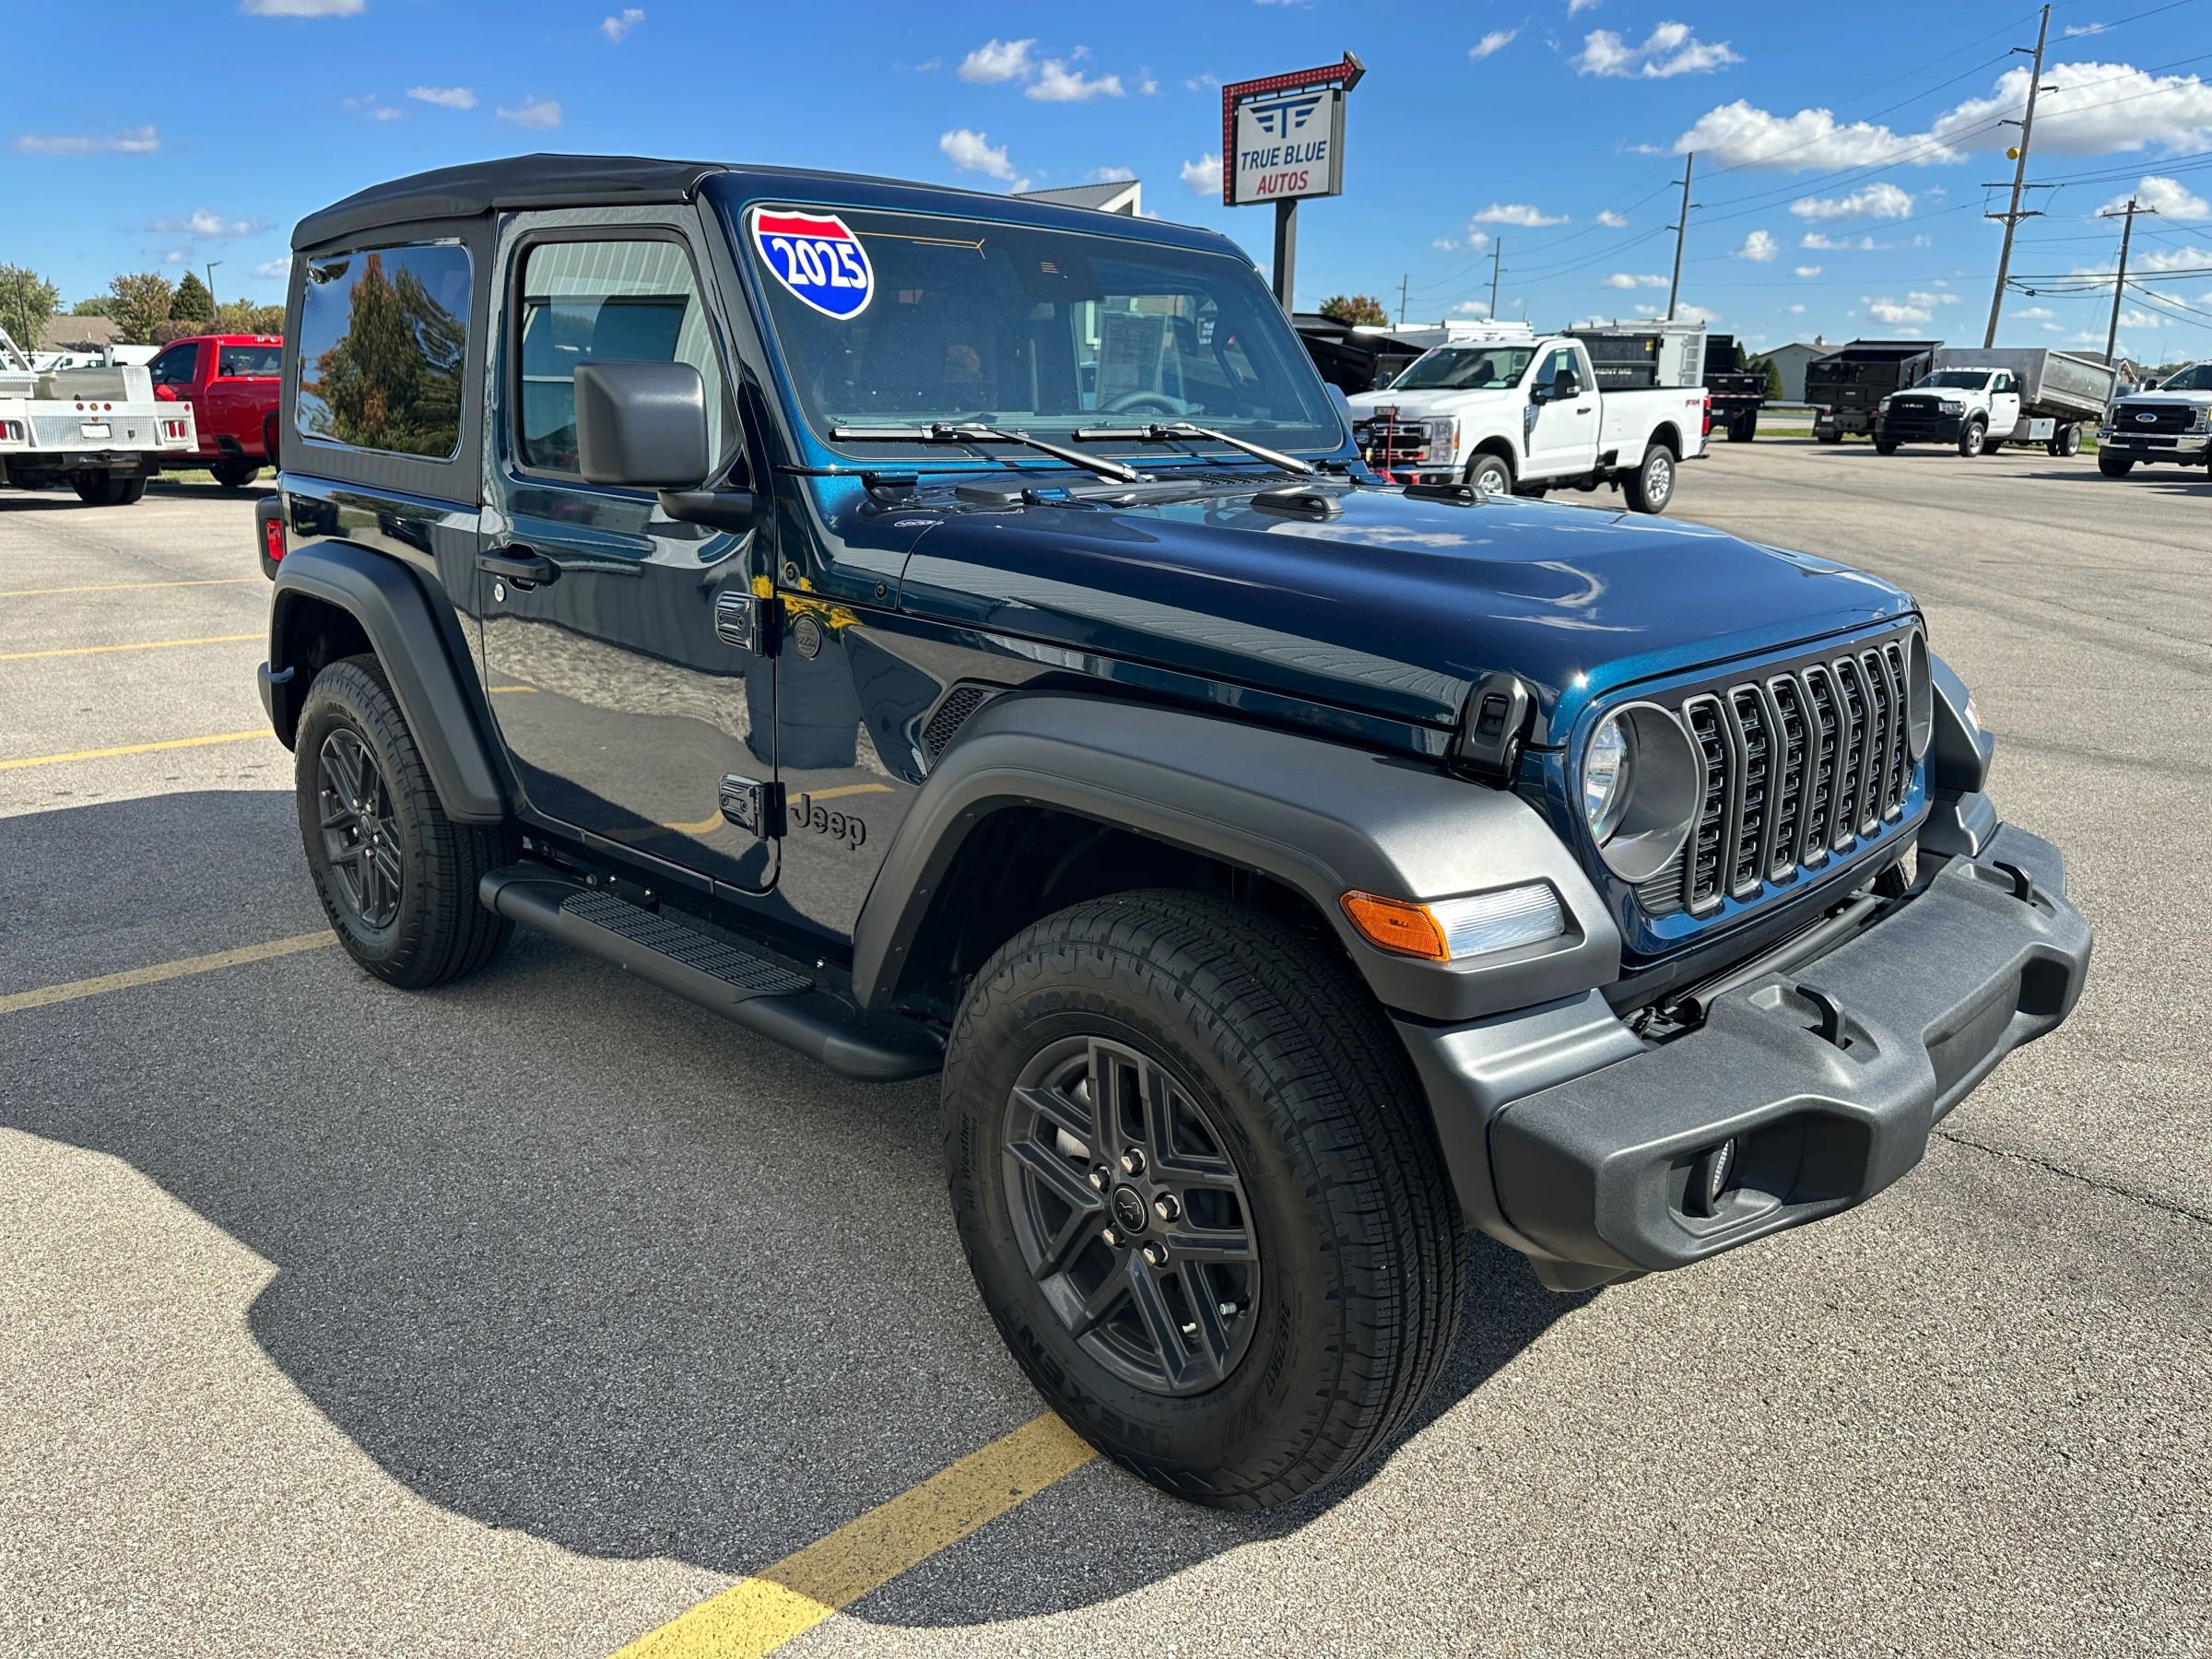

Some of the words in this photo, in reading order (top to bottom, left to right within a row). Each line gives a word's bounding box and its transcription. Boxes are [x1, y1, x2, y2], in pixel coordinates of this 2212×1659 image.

[1241, 147, 1280, 171] TRUE
[1284, 140, 1327, 165] BLUE
[1256, 170, 1309, 195] AUTOS
[771, 237, 867, 289] 2025
[789, 794, 866, 851] Jeep
[1017, 1324, 1156, 1447] NEXEN
